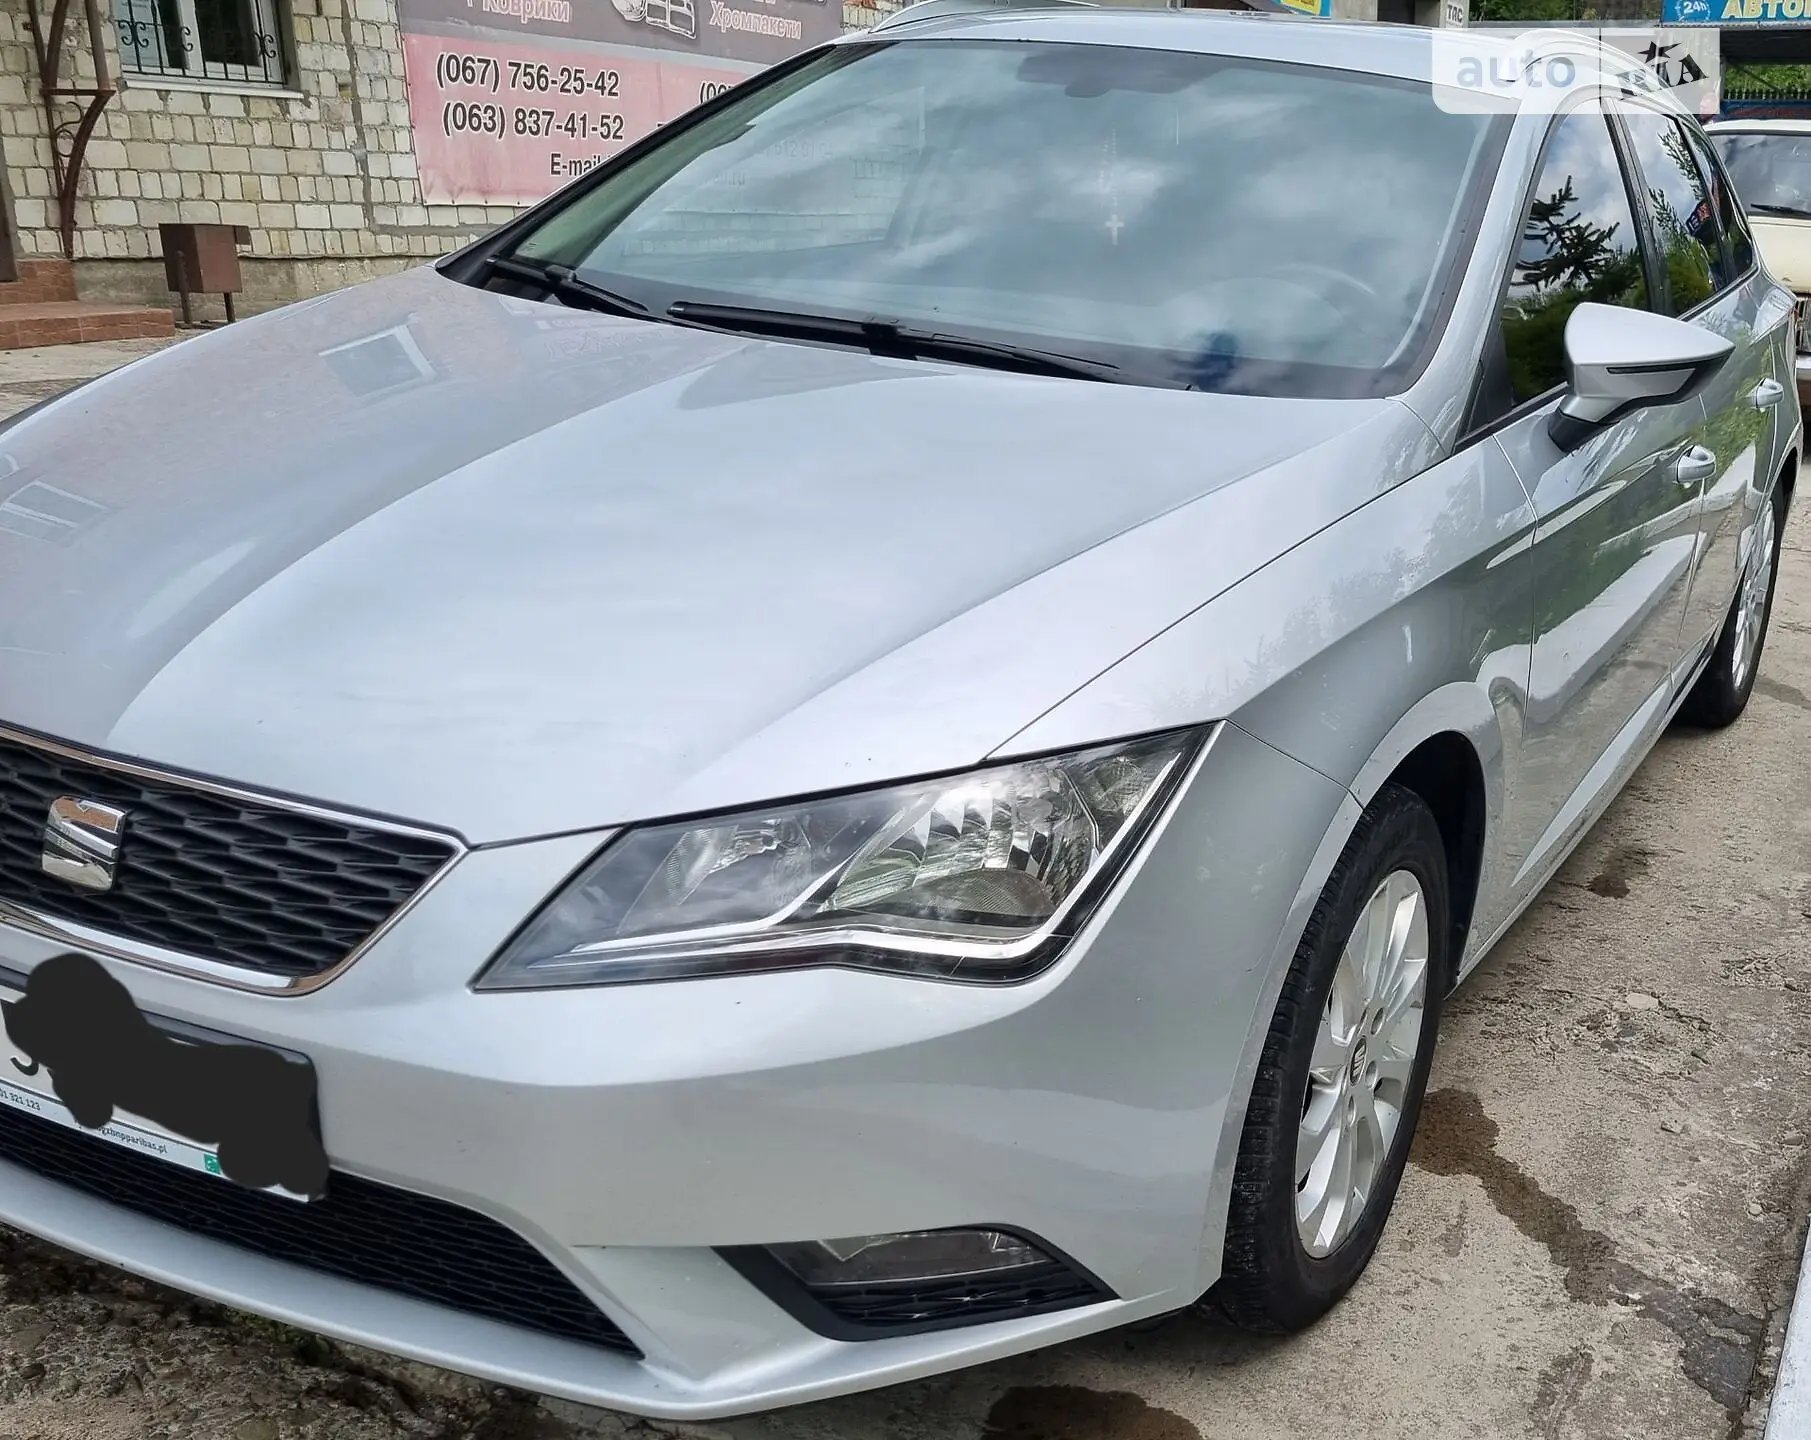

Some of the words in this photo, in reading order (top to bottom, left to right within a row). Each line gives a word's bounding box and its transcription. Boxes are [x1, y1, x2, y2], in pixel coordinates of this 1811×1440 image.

[709, 0, 802, 40] Хромпакети
[1683, 1, 1708, 14] 24h
[1720, 0, 1811, 19] АВТО
[436, 53, 500, 93] (067)
[508, 61, 620, 97] 756-25-42
[443, 102, 506, 139] (063)
[514, 107, 625, 140] 837-41-52
